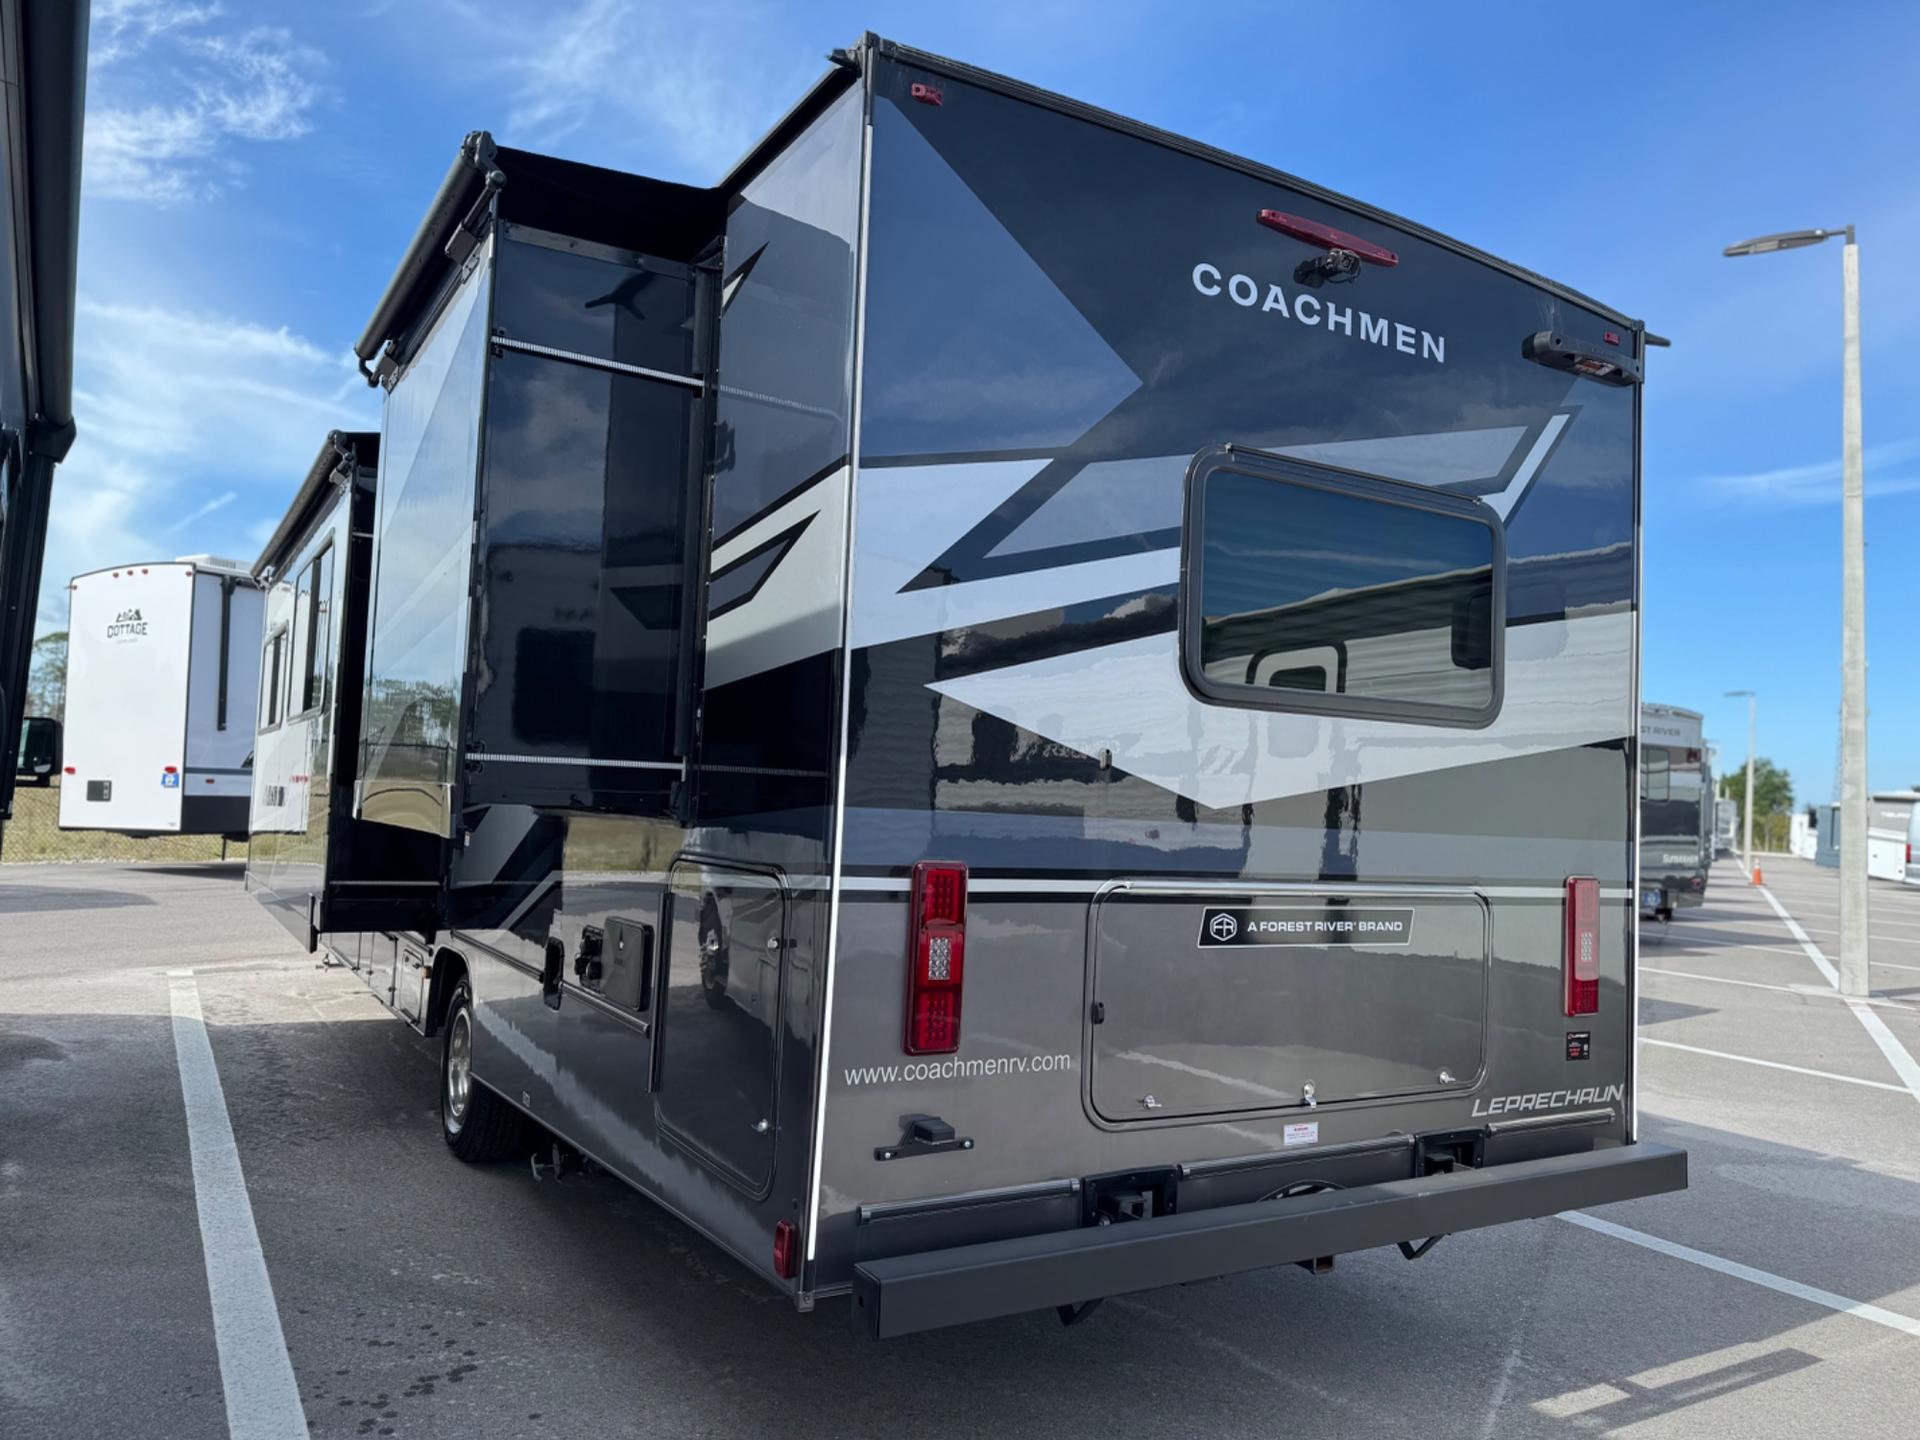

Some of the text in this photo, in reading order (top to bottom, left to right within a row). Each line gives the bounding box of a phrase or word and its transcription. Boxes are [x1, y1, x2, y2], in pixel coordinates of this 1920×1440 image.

[1192, 263, 1446, 364] COACHMEN
[107, 622, 148, 638] COTTAGE
[1653, 726, 1681, 736] RIVER
[1247, 921, 1258, 932] A
[1259, 921, 1313, 932] FOREST
[1358, 921, 1404, 932] BRAND
[844, 1053, 1071, 1086] www.coachmenrv.com
[1471, 1083, 1624, 1117] LEPRECHAUN
